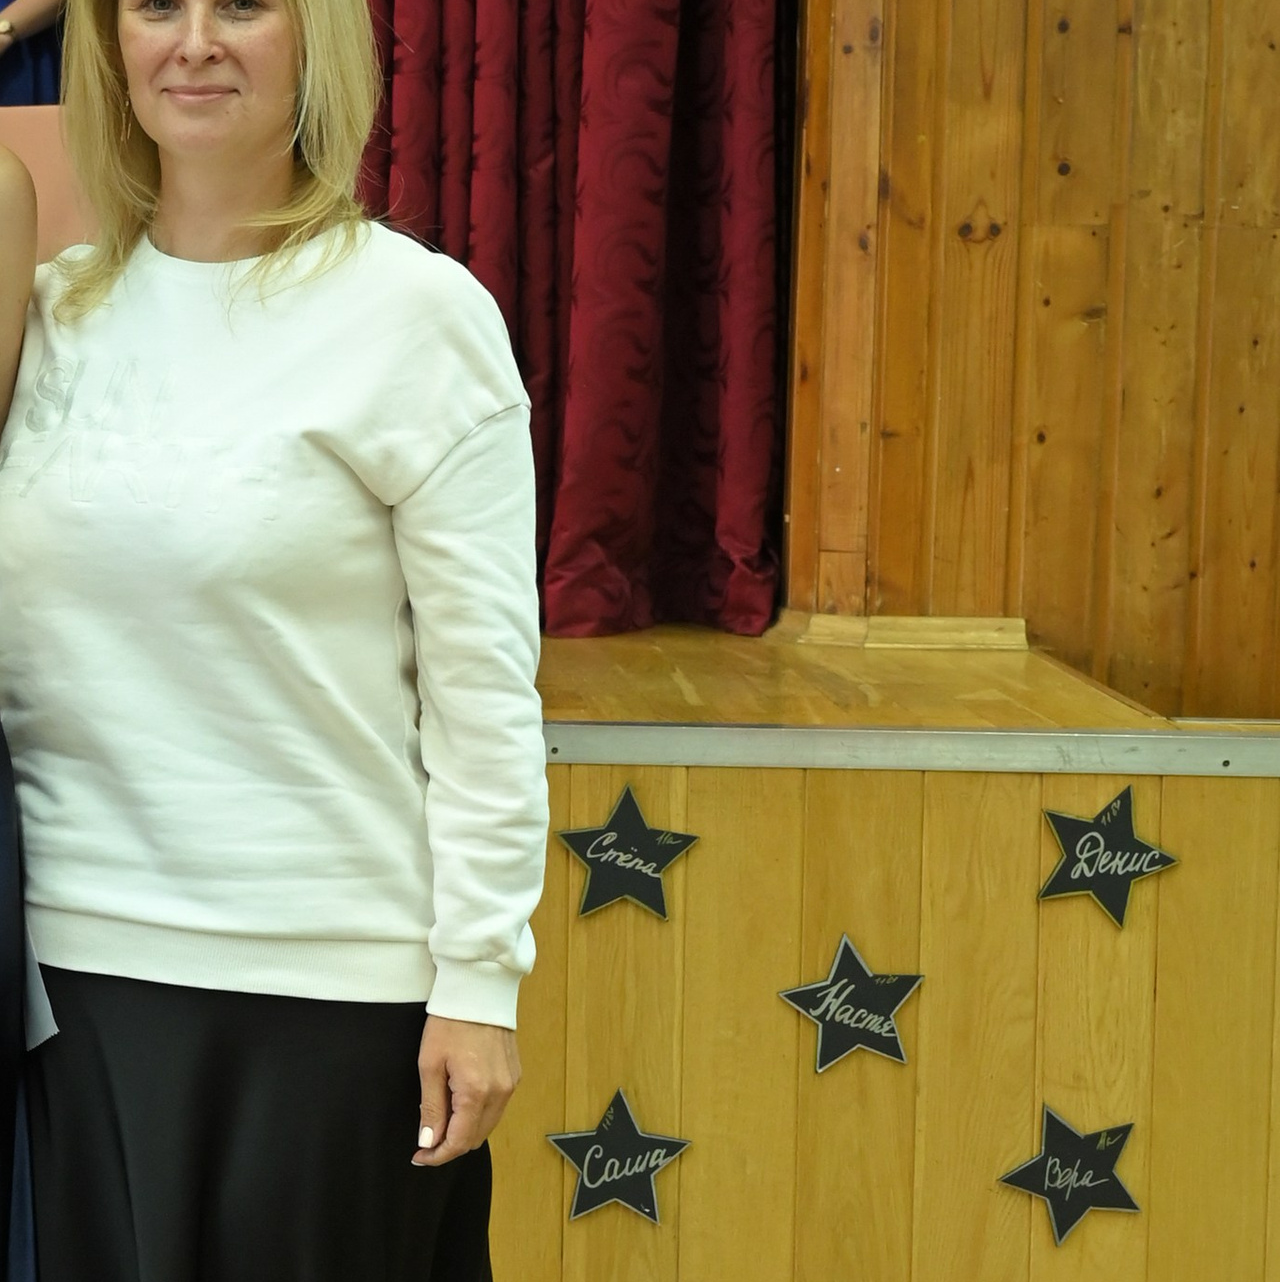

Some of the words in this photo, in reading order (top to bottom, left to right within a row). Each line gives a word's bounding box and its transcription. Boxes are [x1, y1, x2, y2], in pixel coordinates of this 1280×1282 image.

[586, 832, 662, 878] Стёпа
[1071, 831, 1163, 879] Денис
[809, 978, 898, 1037] Настя
[582, 1144, 671, 1189] Саша
[1044, 1156, 1109, 1202] Вера
